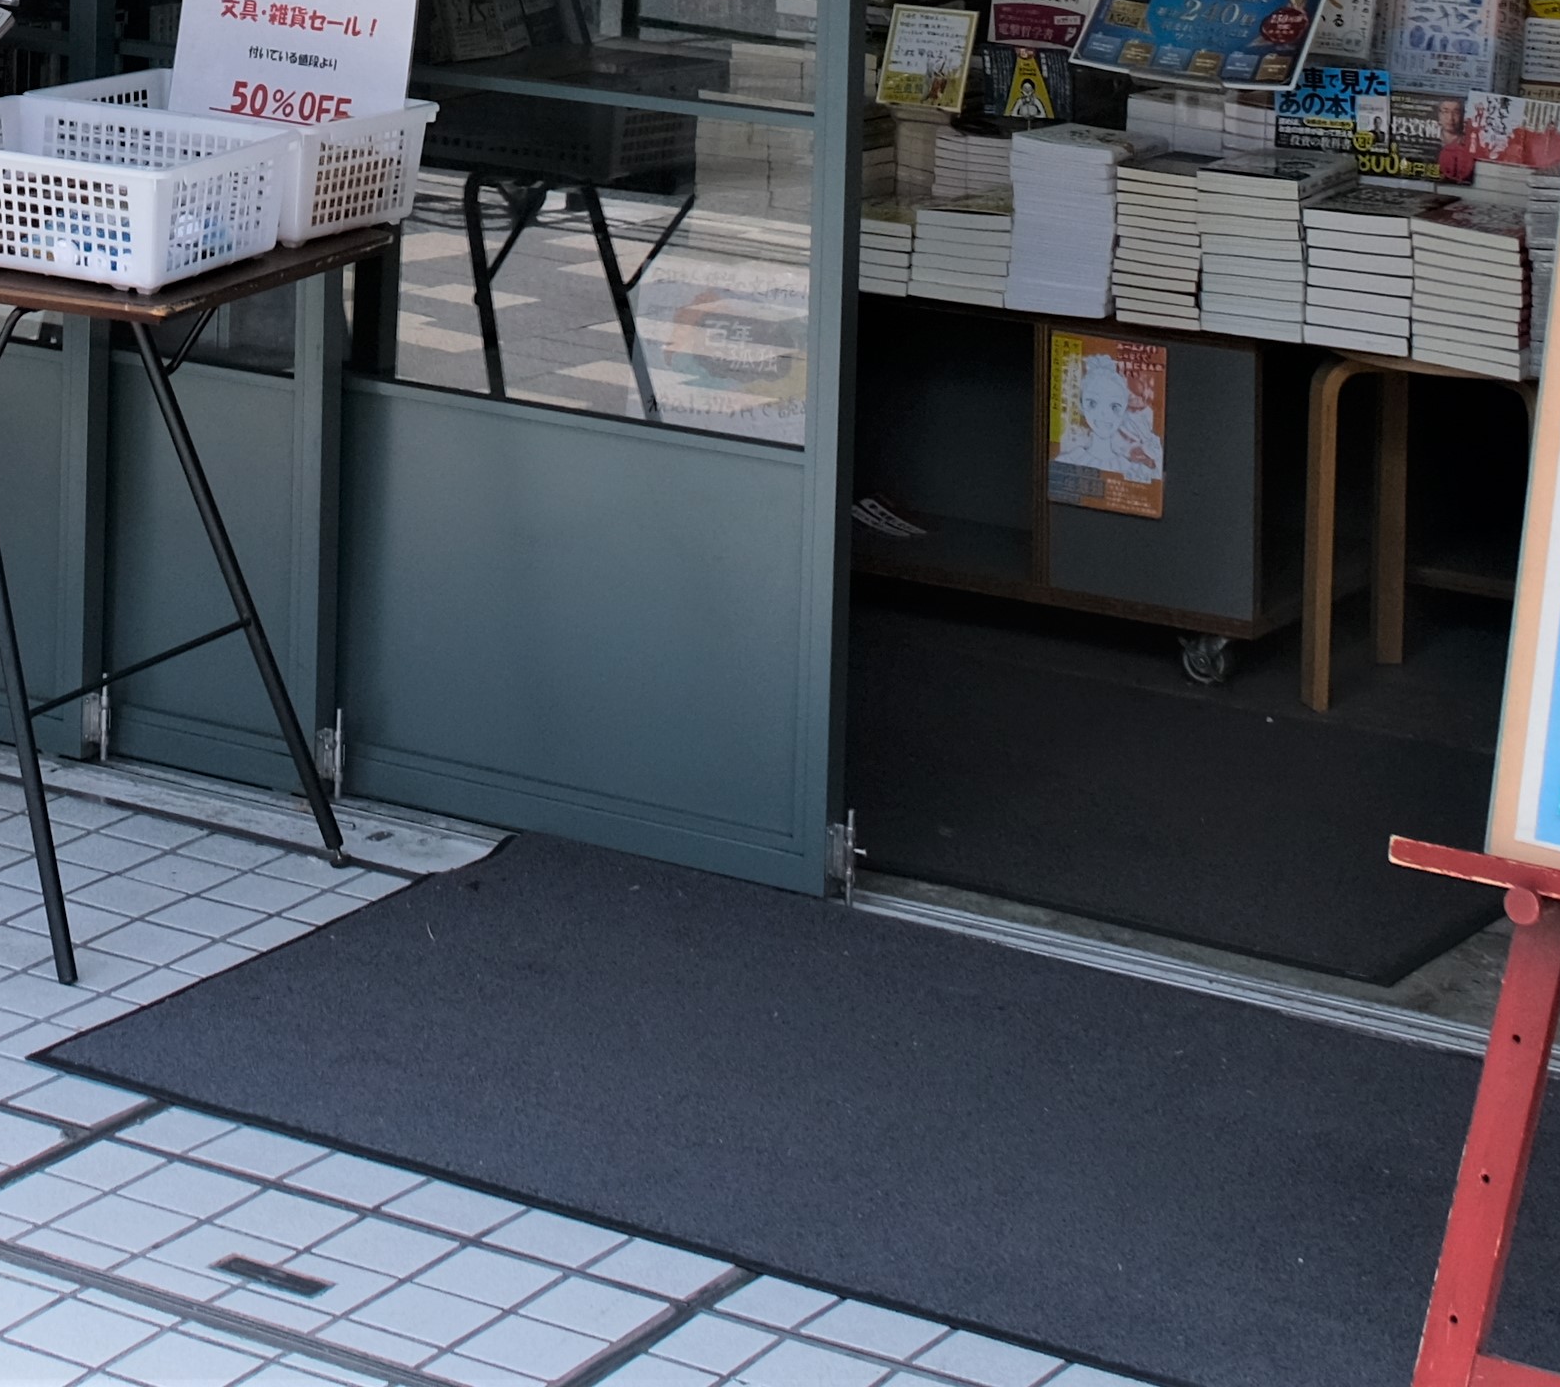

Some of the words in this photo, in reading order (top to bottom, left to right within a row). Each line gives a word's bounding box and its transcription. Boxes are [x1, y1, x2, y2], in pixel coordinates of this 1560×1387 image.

[249, 45, 338, 71] 付いている値段より
[230, 80, 353, 123] 50%OFF
